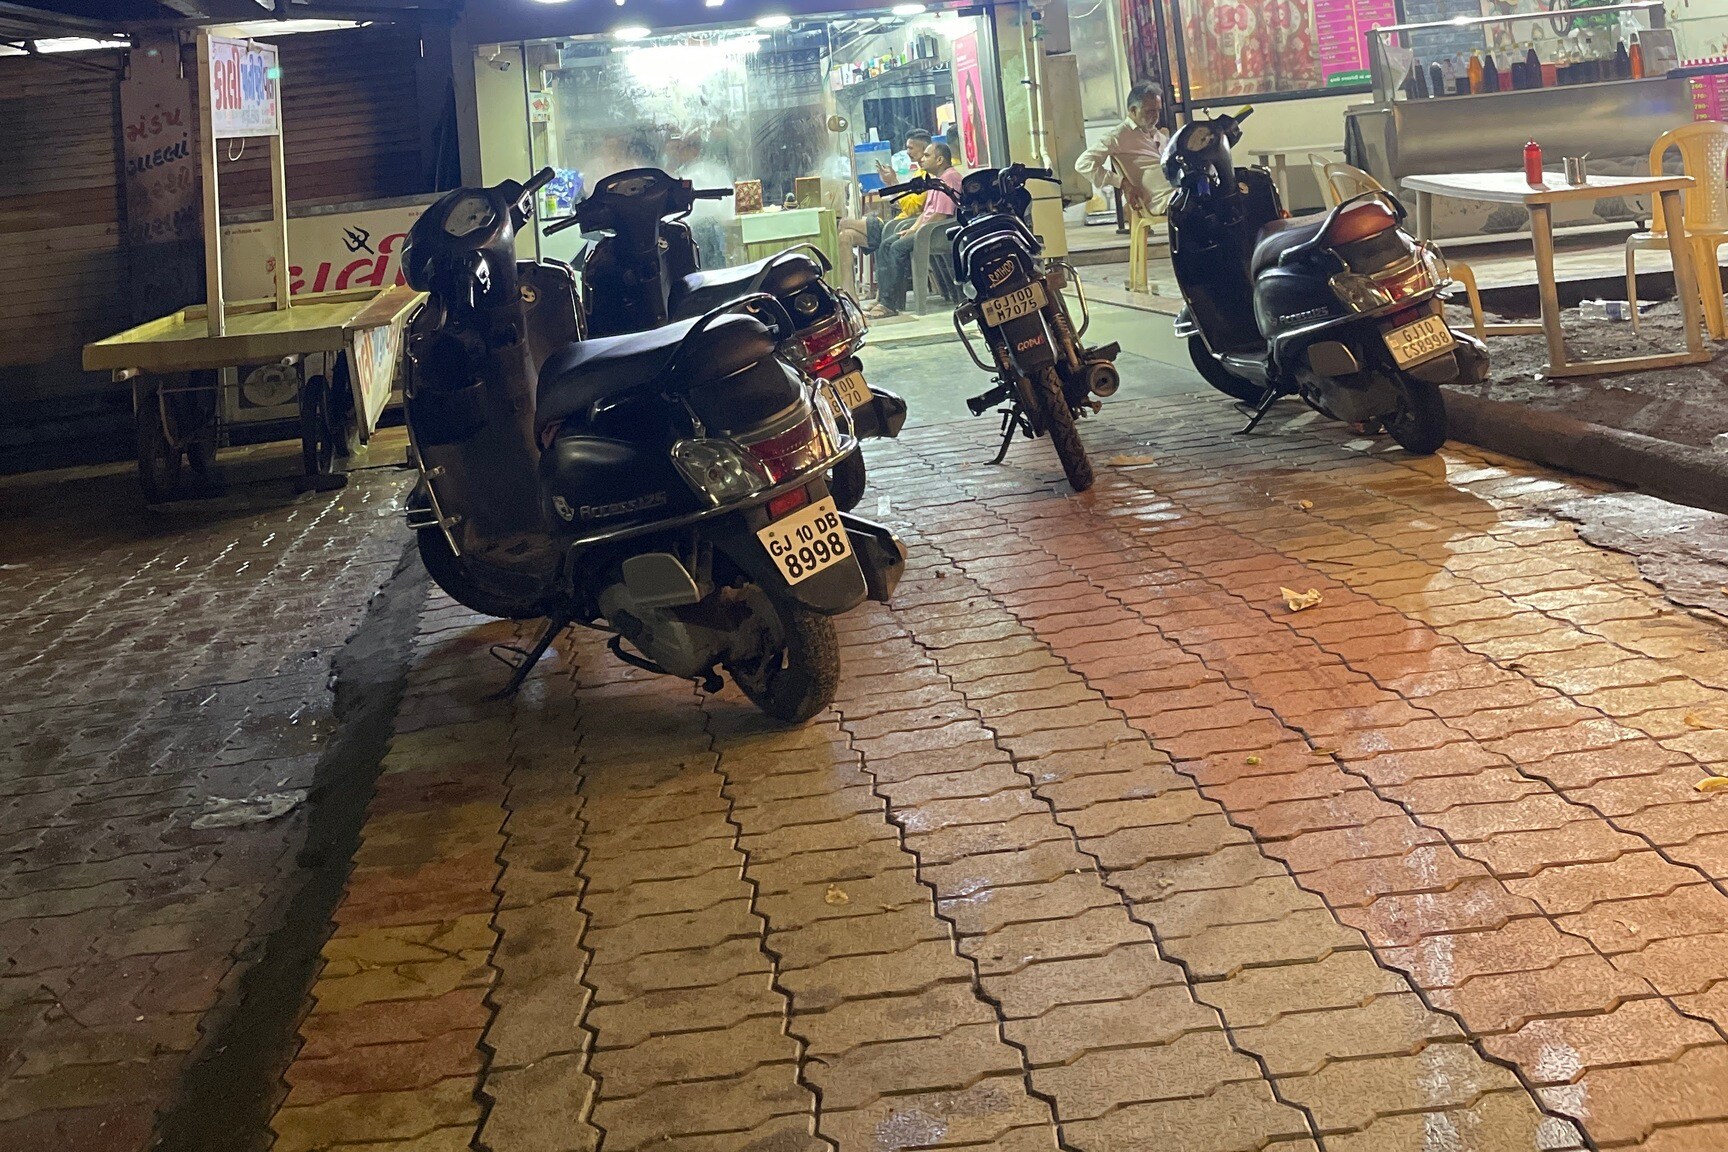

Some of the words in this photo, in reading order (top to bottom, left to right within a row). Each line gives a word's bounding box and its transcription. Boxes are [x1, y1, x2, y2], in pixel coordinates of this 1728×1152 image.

[988, 259, 1015, 284] RATHOD
[994, 287, 1034, 310] GJ10D
[1402, 331, 1450, 359] CS8998
[1403, 322, 1434, 343] GJ10
[769, 534, 793, 558] GJ
[795, 524, 815, 546] 10
[817, 512, 840, 533] DB
[784, 531, 847, 580] 8998
